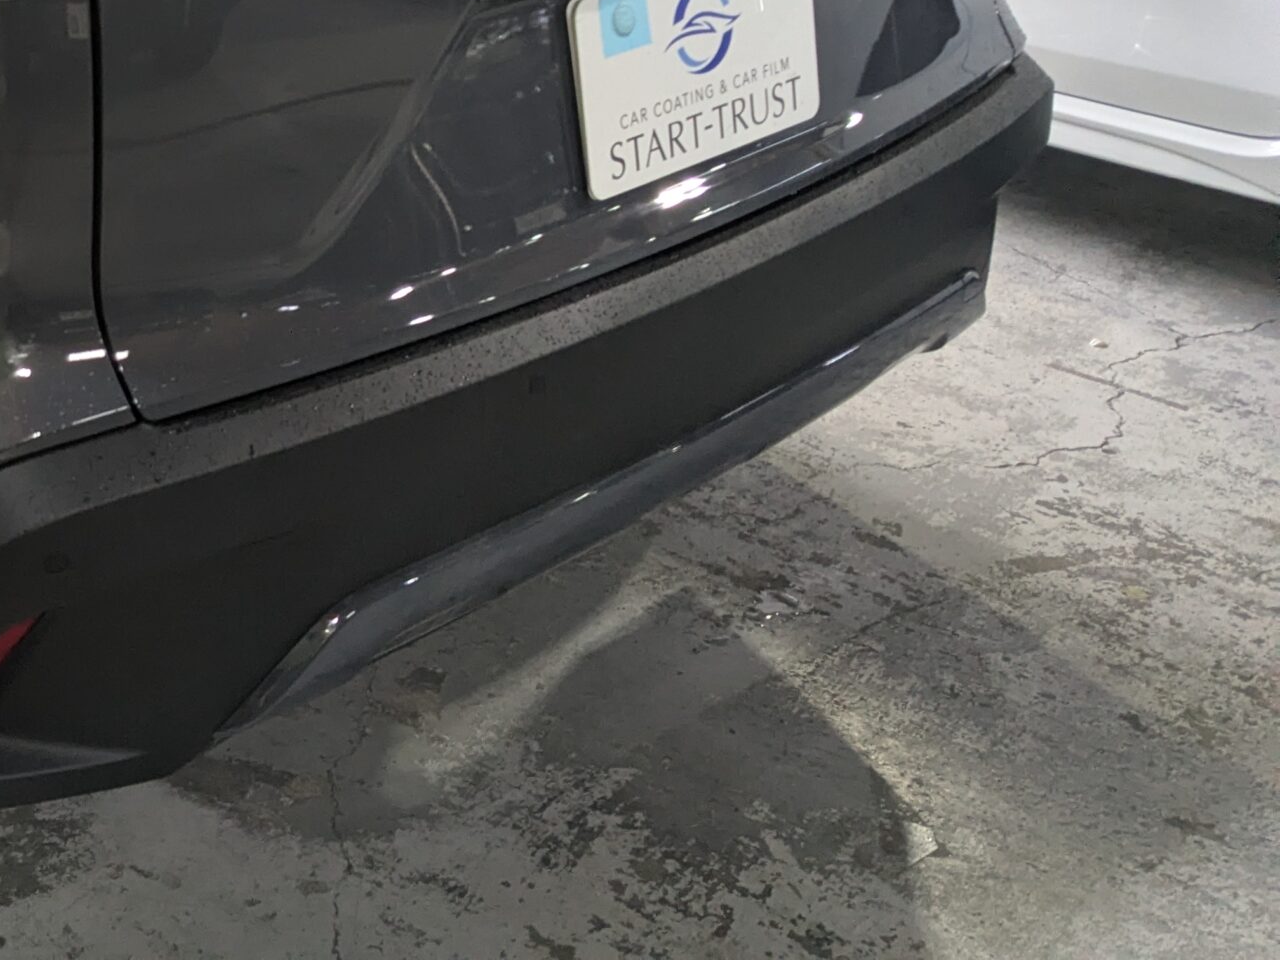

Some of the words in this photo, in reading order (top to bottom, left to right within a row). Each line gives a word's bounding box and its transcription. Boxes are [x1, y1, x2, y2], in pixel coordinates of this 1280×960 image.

[609, 75, 801, 181] START-TRUST
[619, 107, 649, 130] CAR
[652, 83, 715, 118] COATING
[719, 79, 728, 95] &
[732, 68, 759, 90] CAR
[762, 56, 791, 79] FILM
